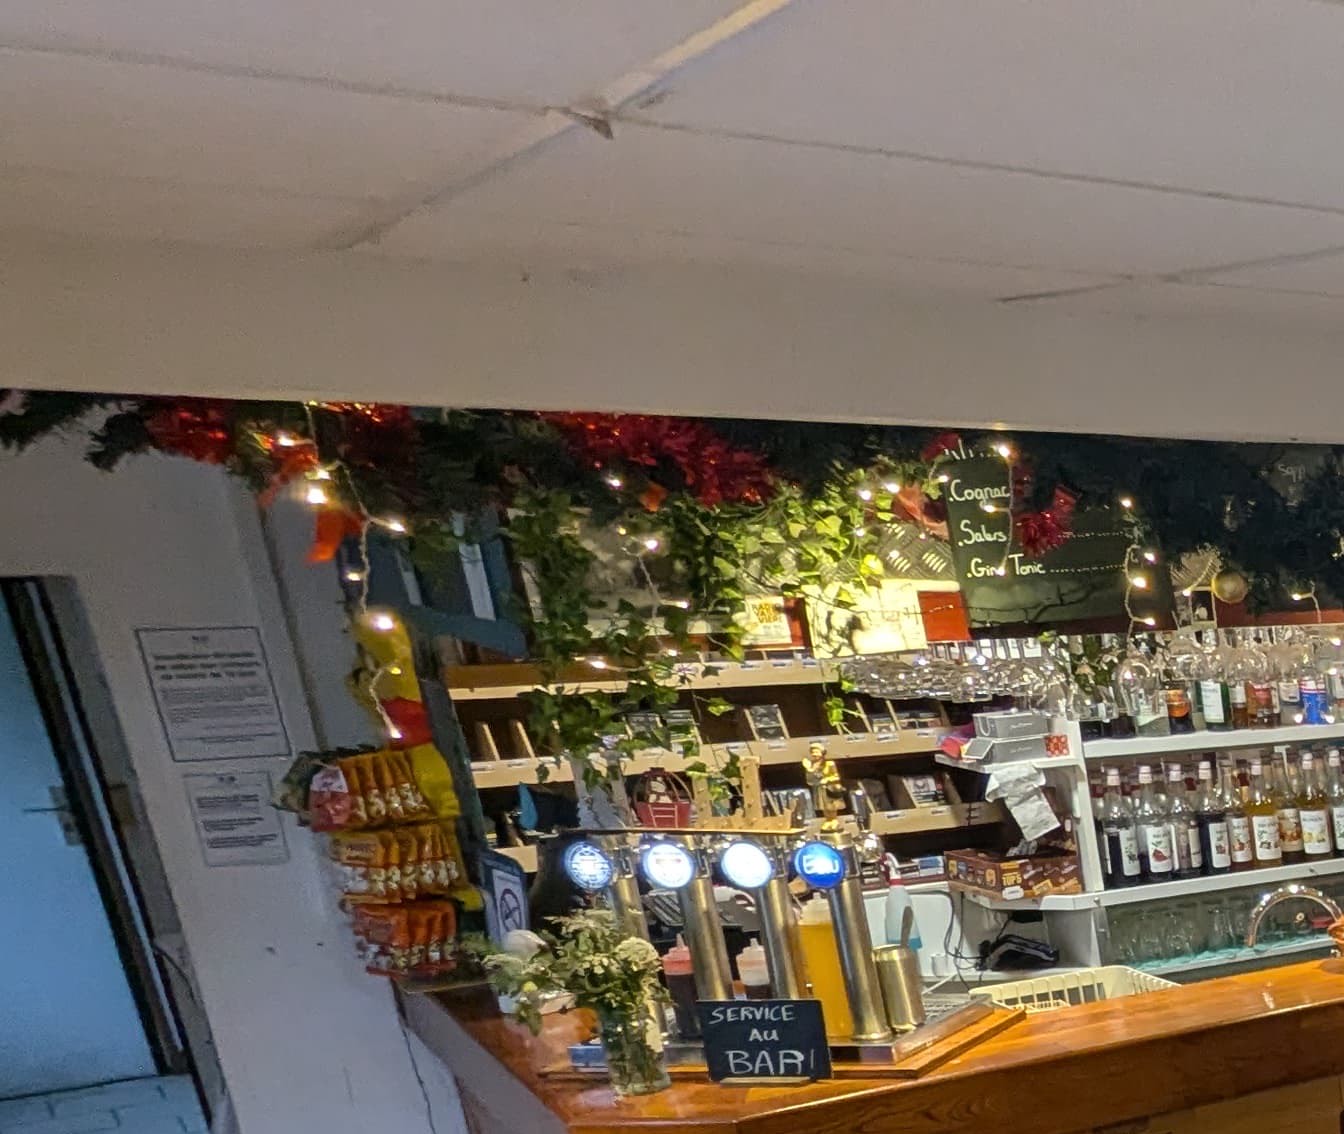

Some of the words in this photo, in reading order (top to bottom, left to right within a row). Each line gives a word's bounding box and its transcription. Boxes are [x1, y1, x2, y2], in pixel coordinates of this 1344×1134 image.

[950, 478, 1010, 507] Cognac
[1008, 553, 1047, 576] Tonic
[708, 1004, 796, 1025] SERVICE
[748, 1028, 780, 1043] AU
